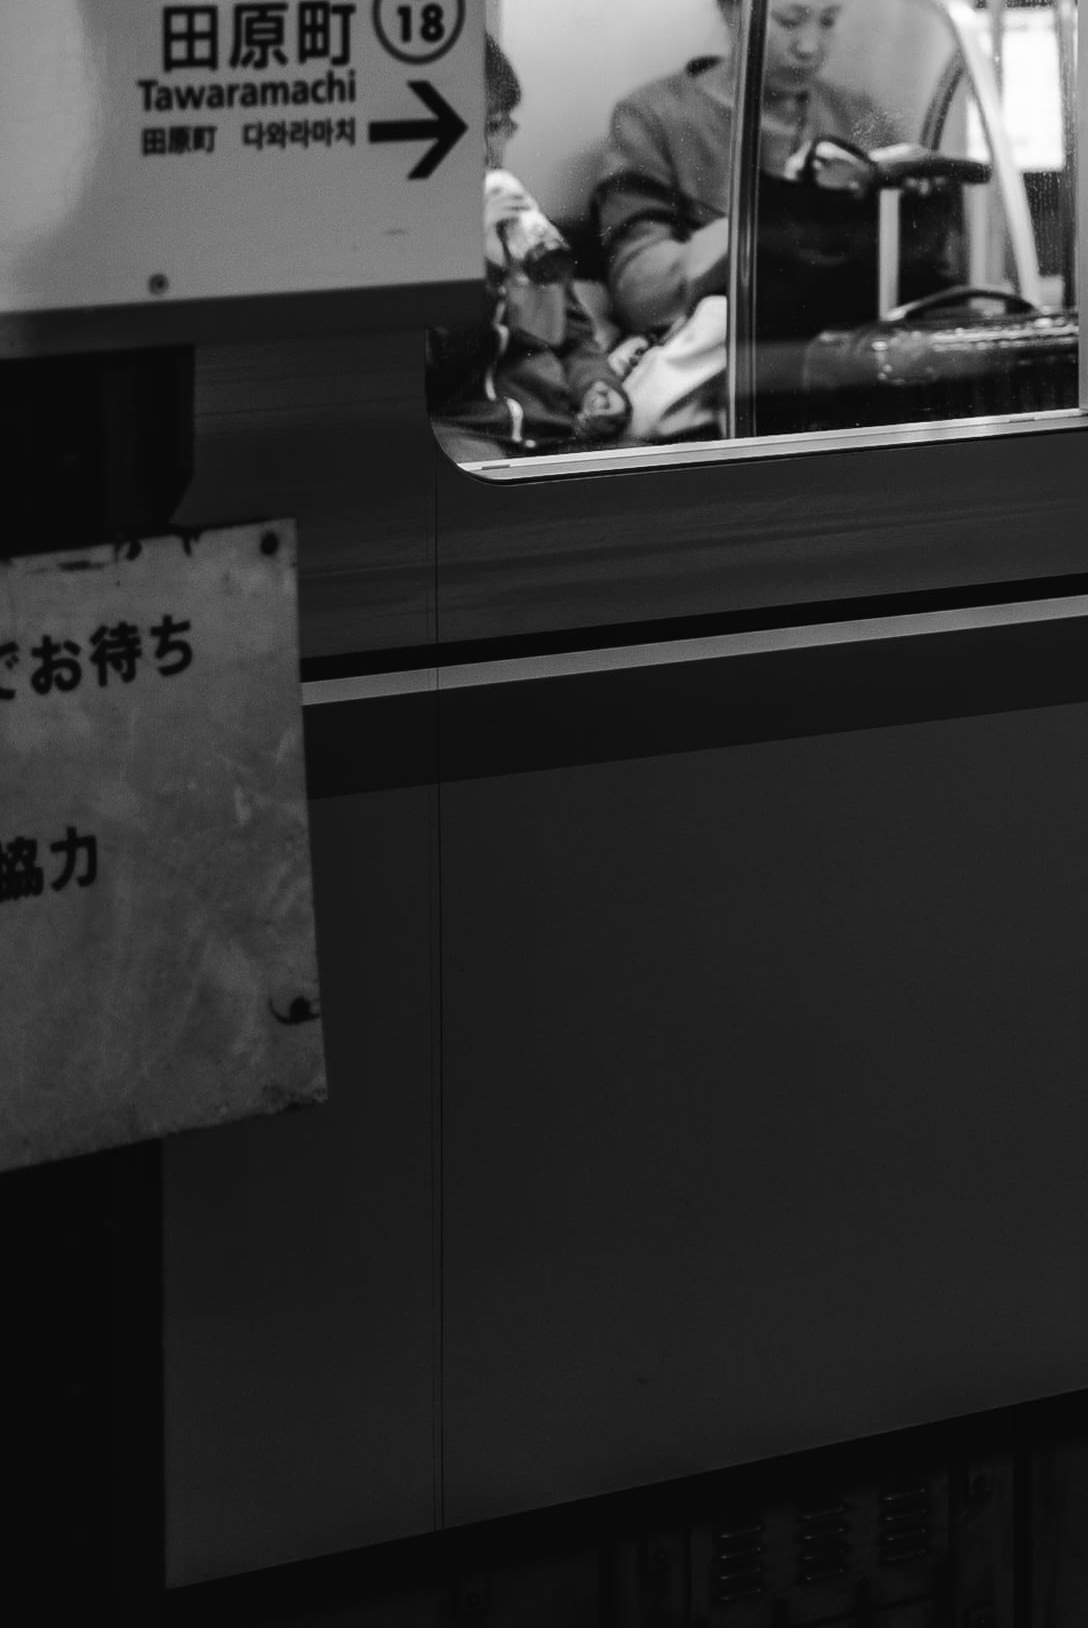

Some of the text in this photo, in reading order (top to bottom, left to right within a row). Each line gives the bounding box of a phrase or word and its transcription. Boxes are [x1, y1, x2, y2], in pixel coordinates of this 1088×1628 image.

[162, 0, 356, 72] 田原町
[396, 4, 445, 43] 18
[137, 70, 356, 112] Tawaramachi
[142, 126, 216, 156] 田原町
[241, 118, 356, 151] 다와라마치
